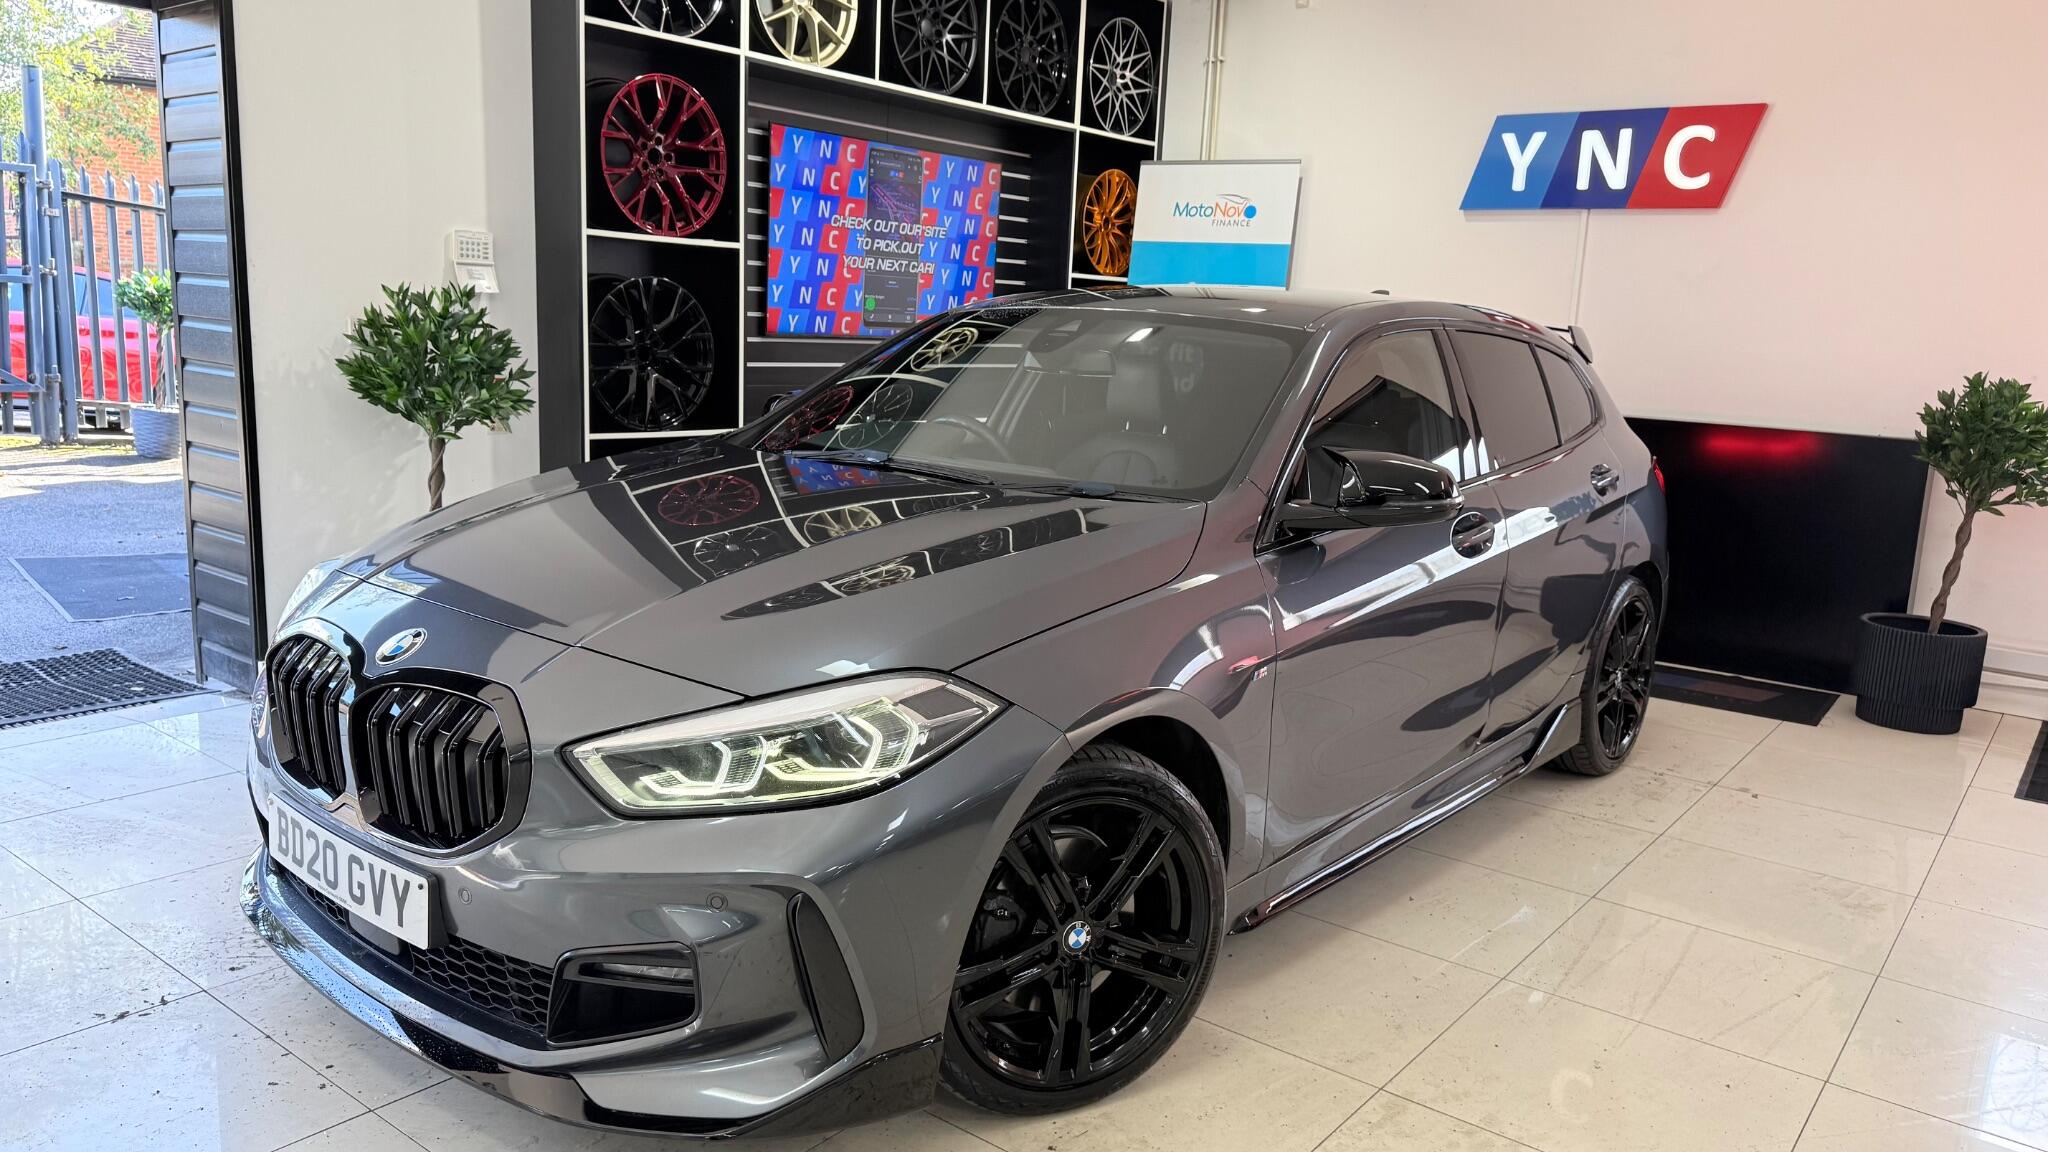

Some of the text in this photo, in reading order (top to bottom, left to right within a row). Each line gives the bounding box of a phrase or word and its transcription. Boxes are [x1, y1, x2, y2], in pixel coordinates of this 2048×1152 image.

[831, 214, 948, 239] CHECK OUT OUR SITE
[1211, 219, 1251, 227] FINANCE
[856, 236, 924, 256] TO PICK OUT
[843, 255, 875, 271] YOUR
[876, 257, 909, 273] NEXT
[276, 806, 411, 929] BD20 GVY
